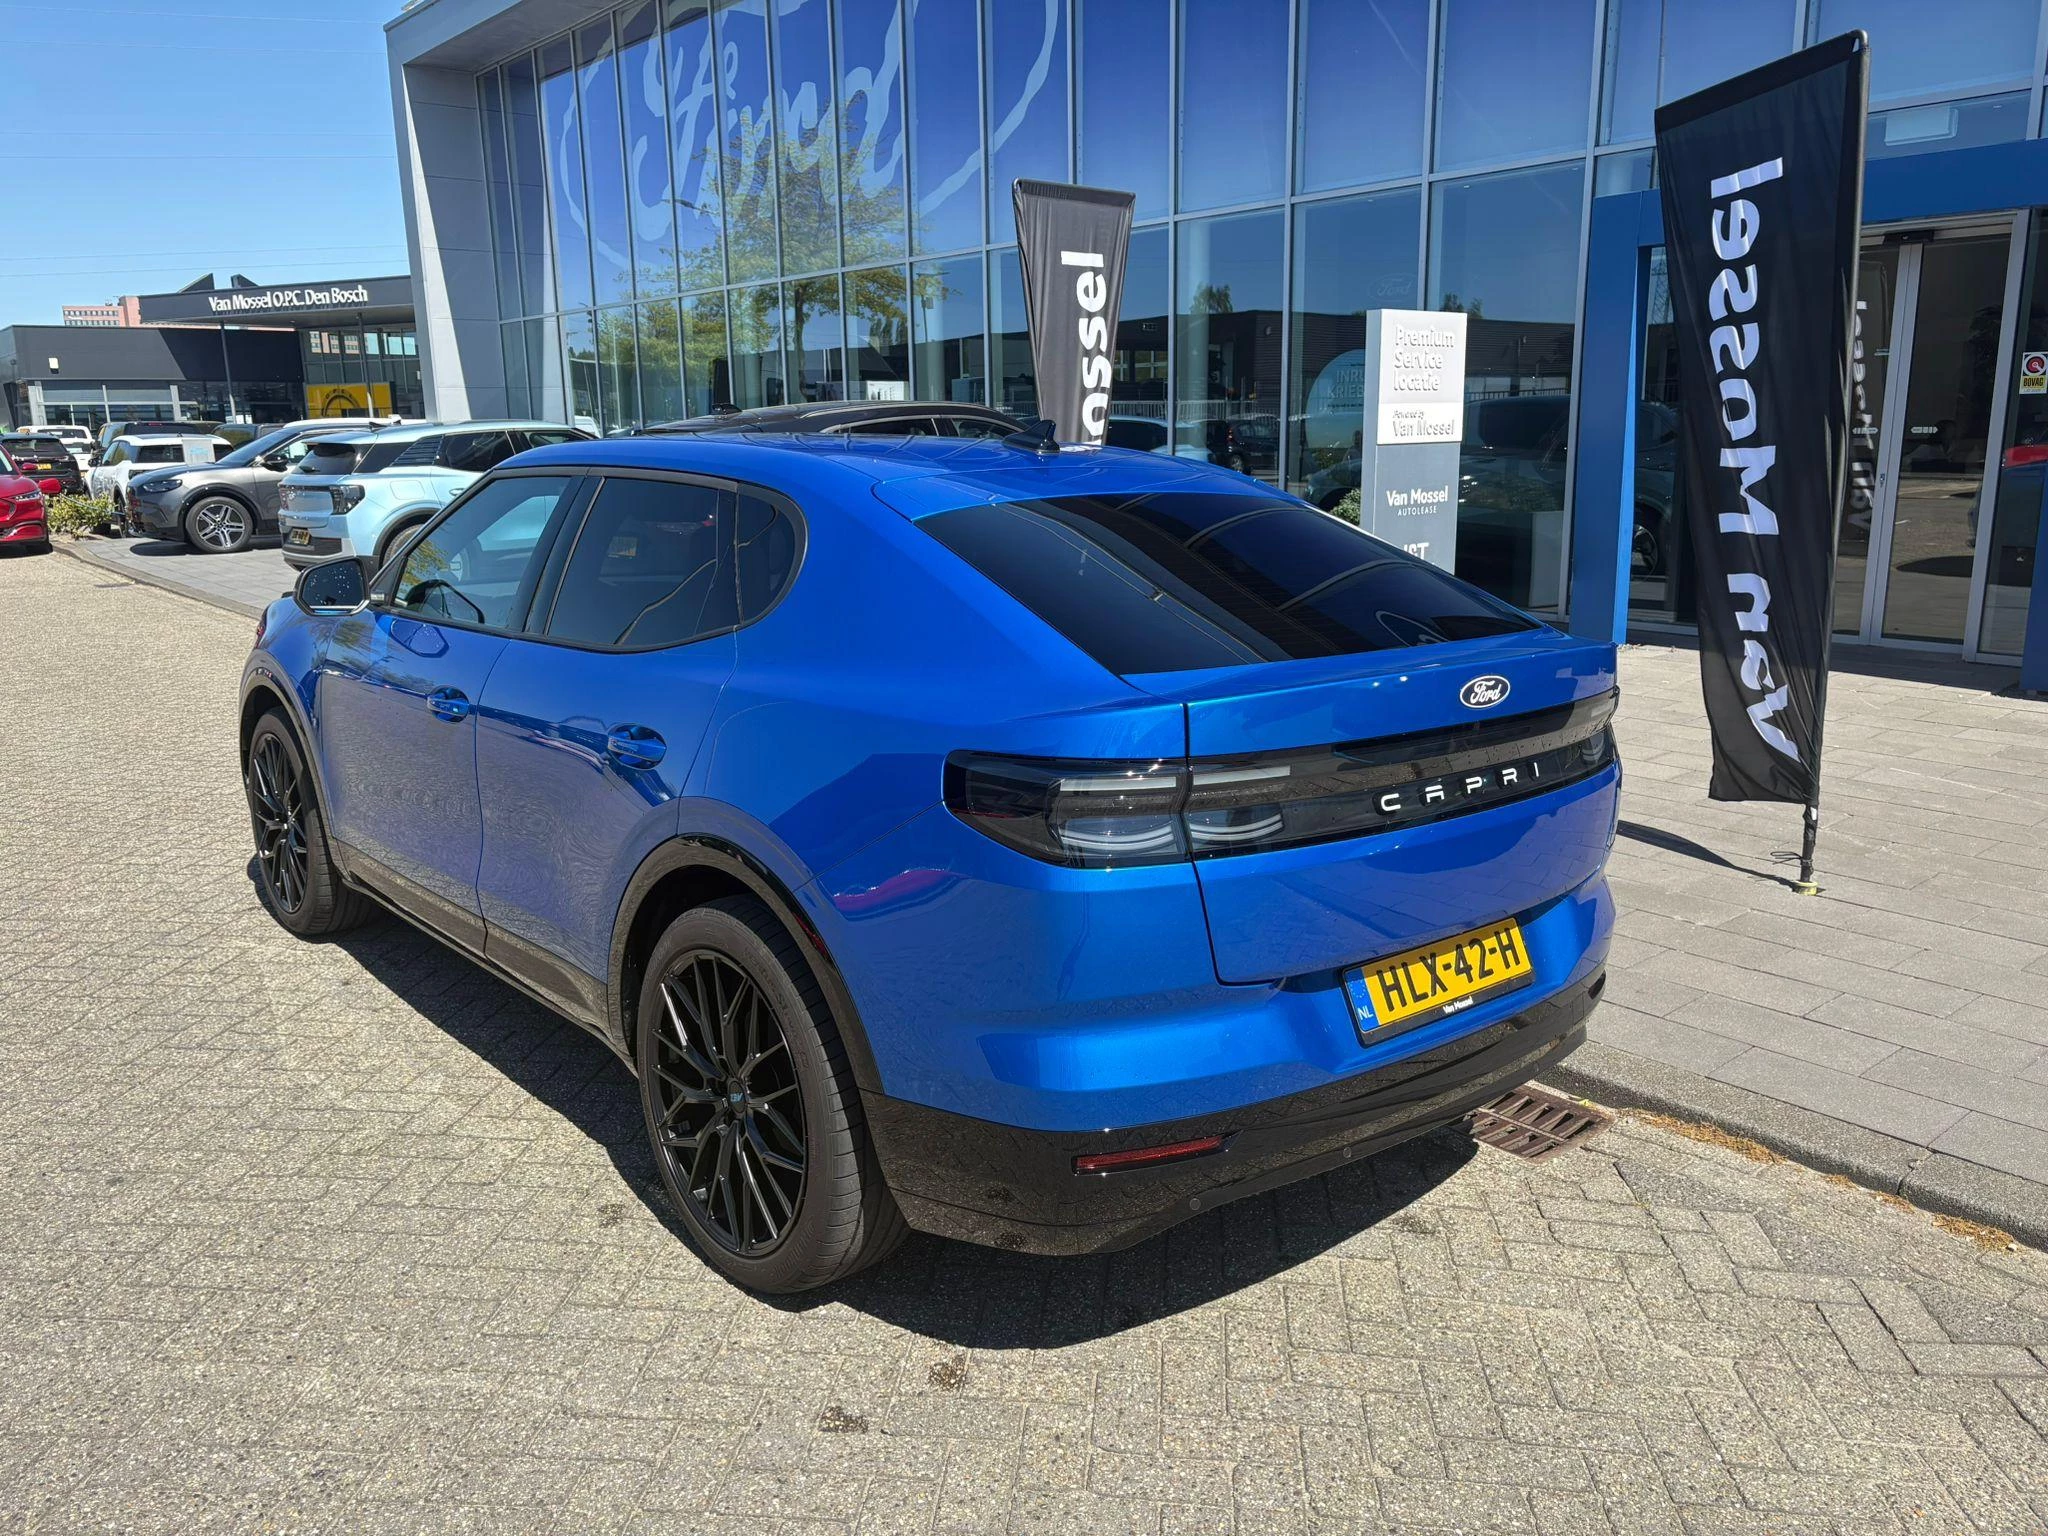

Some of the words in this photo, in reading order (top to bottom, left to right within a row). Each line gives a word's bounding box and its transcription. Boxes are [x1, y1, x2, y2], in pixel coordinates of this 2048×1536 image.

[208, 296, 231, 312] Van
[232, 291, 272, 310] Mossel
[305, 289, 330, 305] Den
[331, 284, 368, 304] Bosch
[1394, 324, 1455, 348] Premium
[1061, 250, 1112, 446] ossel
[1393, 350, 1442, 369] Service
[1393, 370, 1440, 391] locatie
[2023, 377, 2044, 387] BOVAG
[1393, 421, 1413, 437] Van
[1416, 419, 1455, 436] Mossel
[1386, 490, 1408, 507] Van
[1410, 485, 1449, 505] Mossel
[1397, 505, 1437, 516] AUTOLEASE
[1470, 680, 1502, 704] Ford
[1380, 762, 1540, 812] CAPRI
[1376, 927, 1521, 1012] HLX-42-H
[1358, 1007, 1374, 1021] NL
